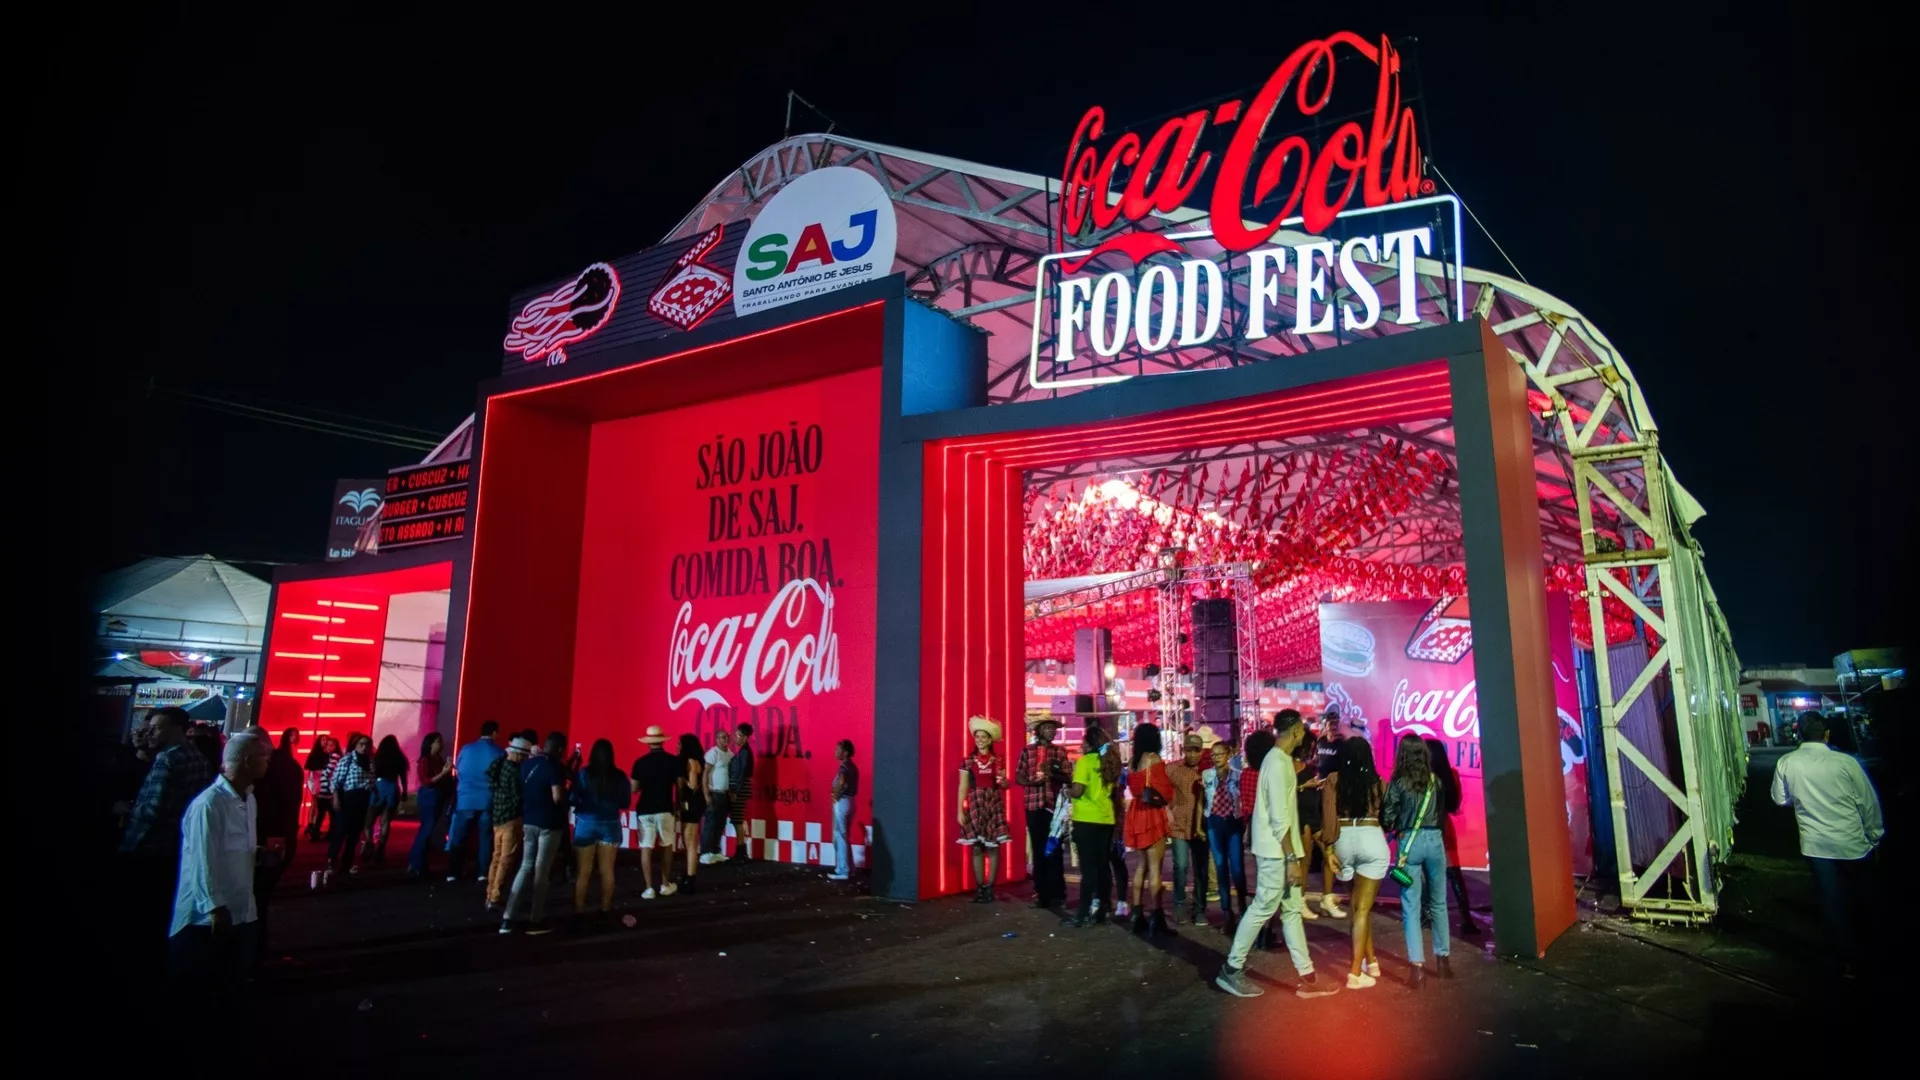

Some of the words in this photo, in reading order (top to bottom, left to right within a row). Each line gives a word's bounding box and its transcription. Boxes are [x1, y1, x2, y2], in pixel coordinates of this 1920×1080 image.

[1057, 31, 1423, 273] Coca-Cola
[745, 209, 877, 281] SAJ
[742, 282, 775, 298] SANTO
[776, 272, 822, 291] ANTÔNIO
[823, 271, 837, 280] DE
[839, 262, 873, 277] JESUS
[742, 292, 801, 309] TRABALHANDO
[804, 287, 827, 296] PARA
[1055, 257, 1224, 363] FOOD
[1245, 227, 1431, 340] FEST
[696, 434, 745, 490] SÃO
[750, 421, 823, 482] JOÃO
[335, 515, 366, 526] ITAGU
[708, 492, 742, 542] DE
[747, 484, 804, 538] SAJ.
[670, 545, 771, 601] COMIDA
[777, 538, 845, 591] BOA.
[667, 577, 841, 711] Coca-Cola
[1391, 679, 1481, 738] Coca-C
[1455, 741, 1481, 769] FE
